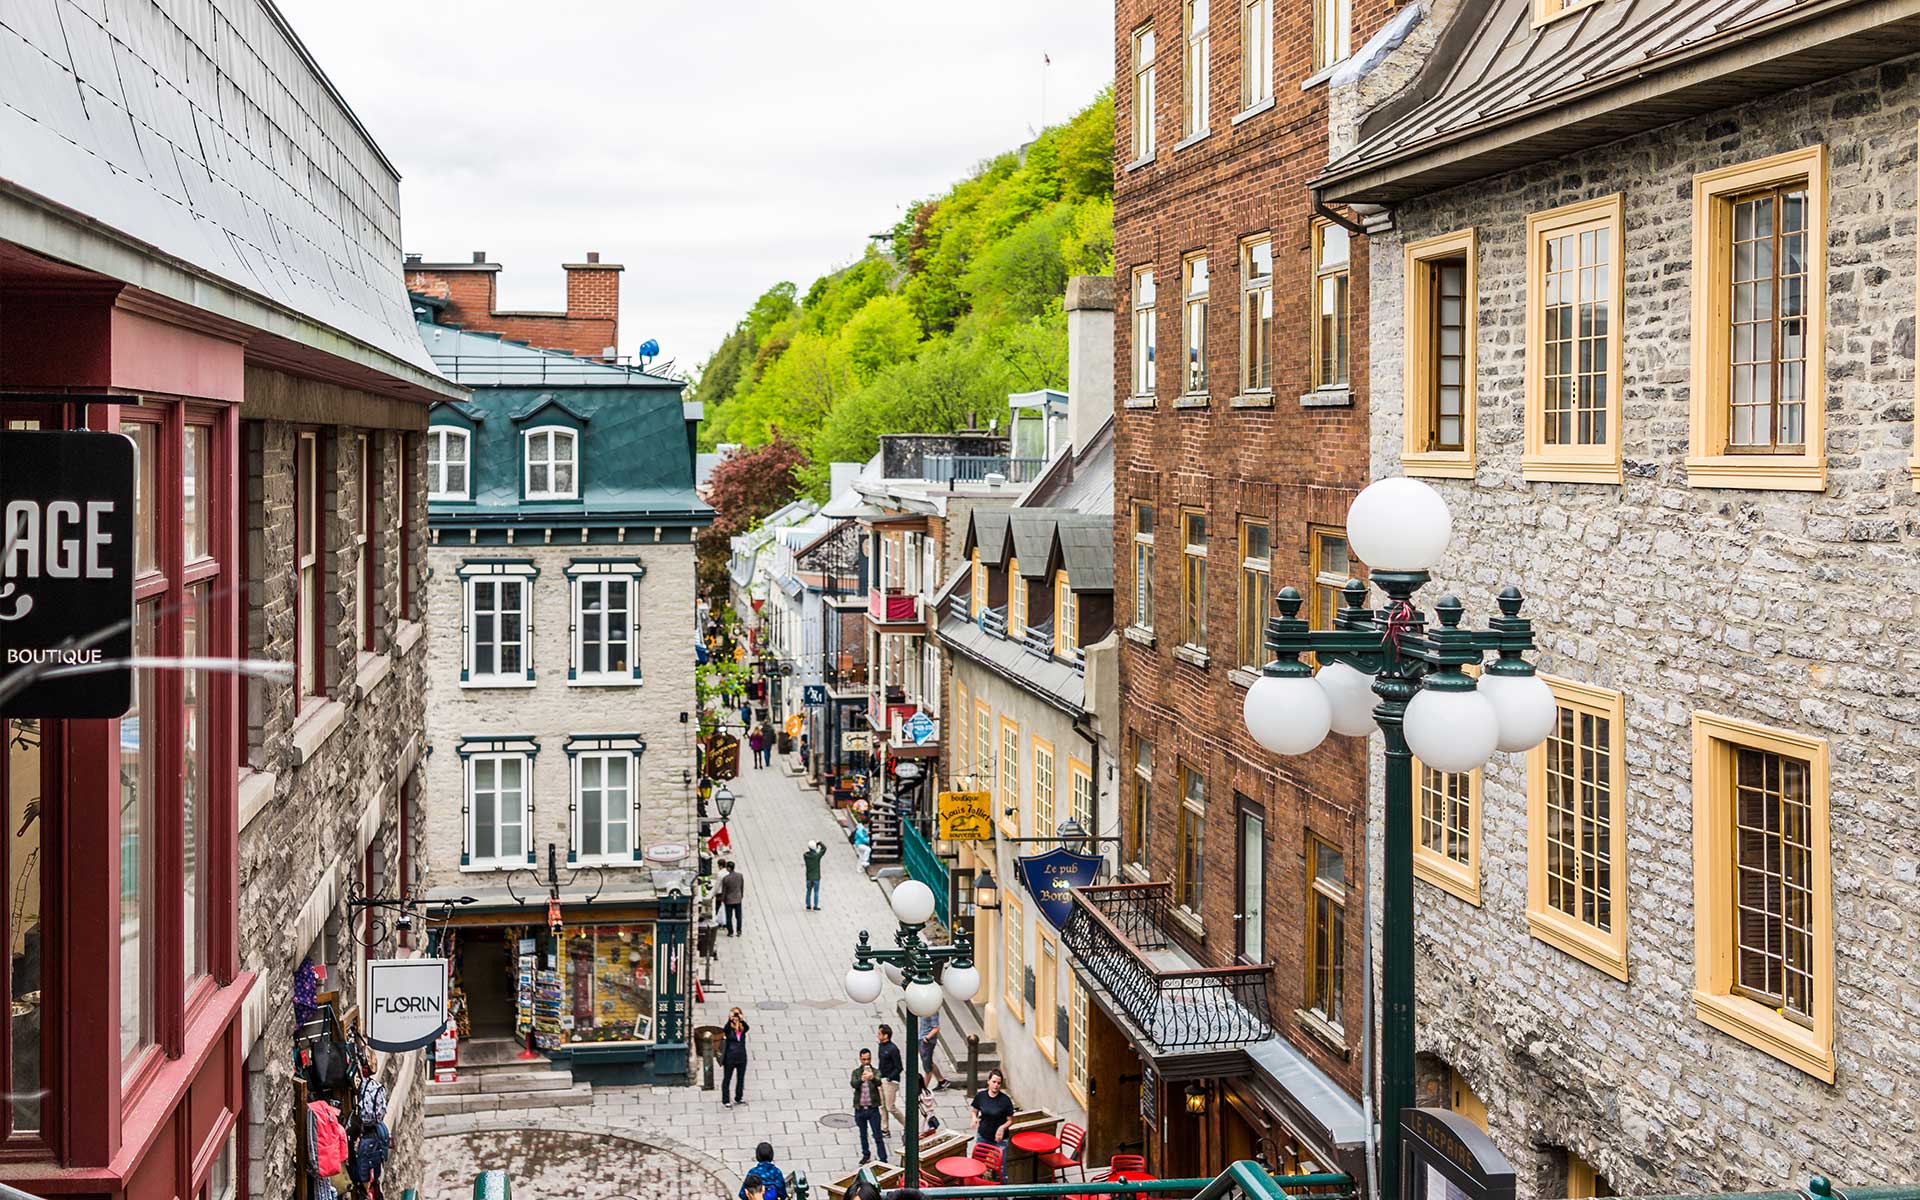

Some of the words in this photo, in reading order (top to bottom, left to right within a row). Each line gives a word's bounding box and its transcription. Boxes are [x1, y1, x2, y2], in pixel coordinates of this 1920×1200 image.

[7, 649, 102, 664] BOUTIQUE
[941, 806, 965, 820] Louis
[1044, 864, 1057, 874] Le
[1060, 863, 1078, 875] pub
[1052, 877, 1069, 888] des
[375, 996, 440, 1013] FLORIN
[1410, 1111, 1423, 1133] LE
[1426, 1123, 1473, 1171] REPAIRE
